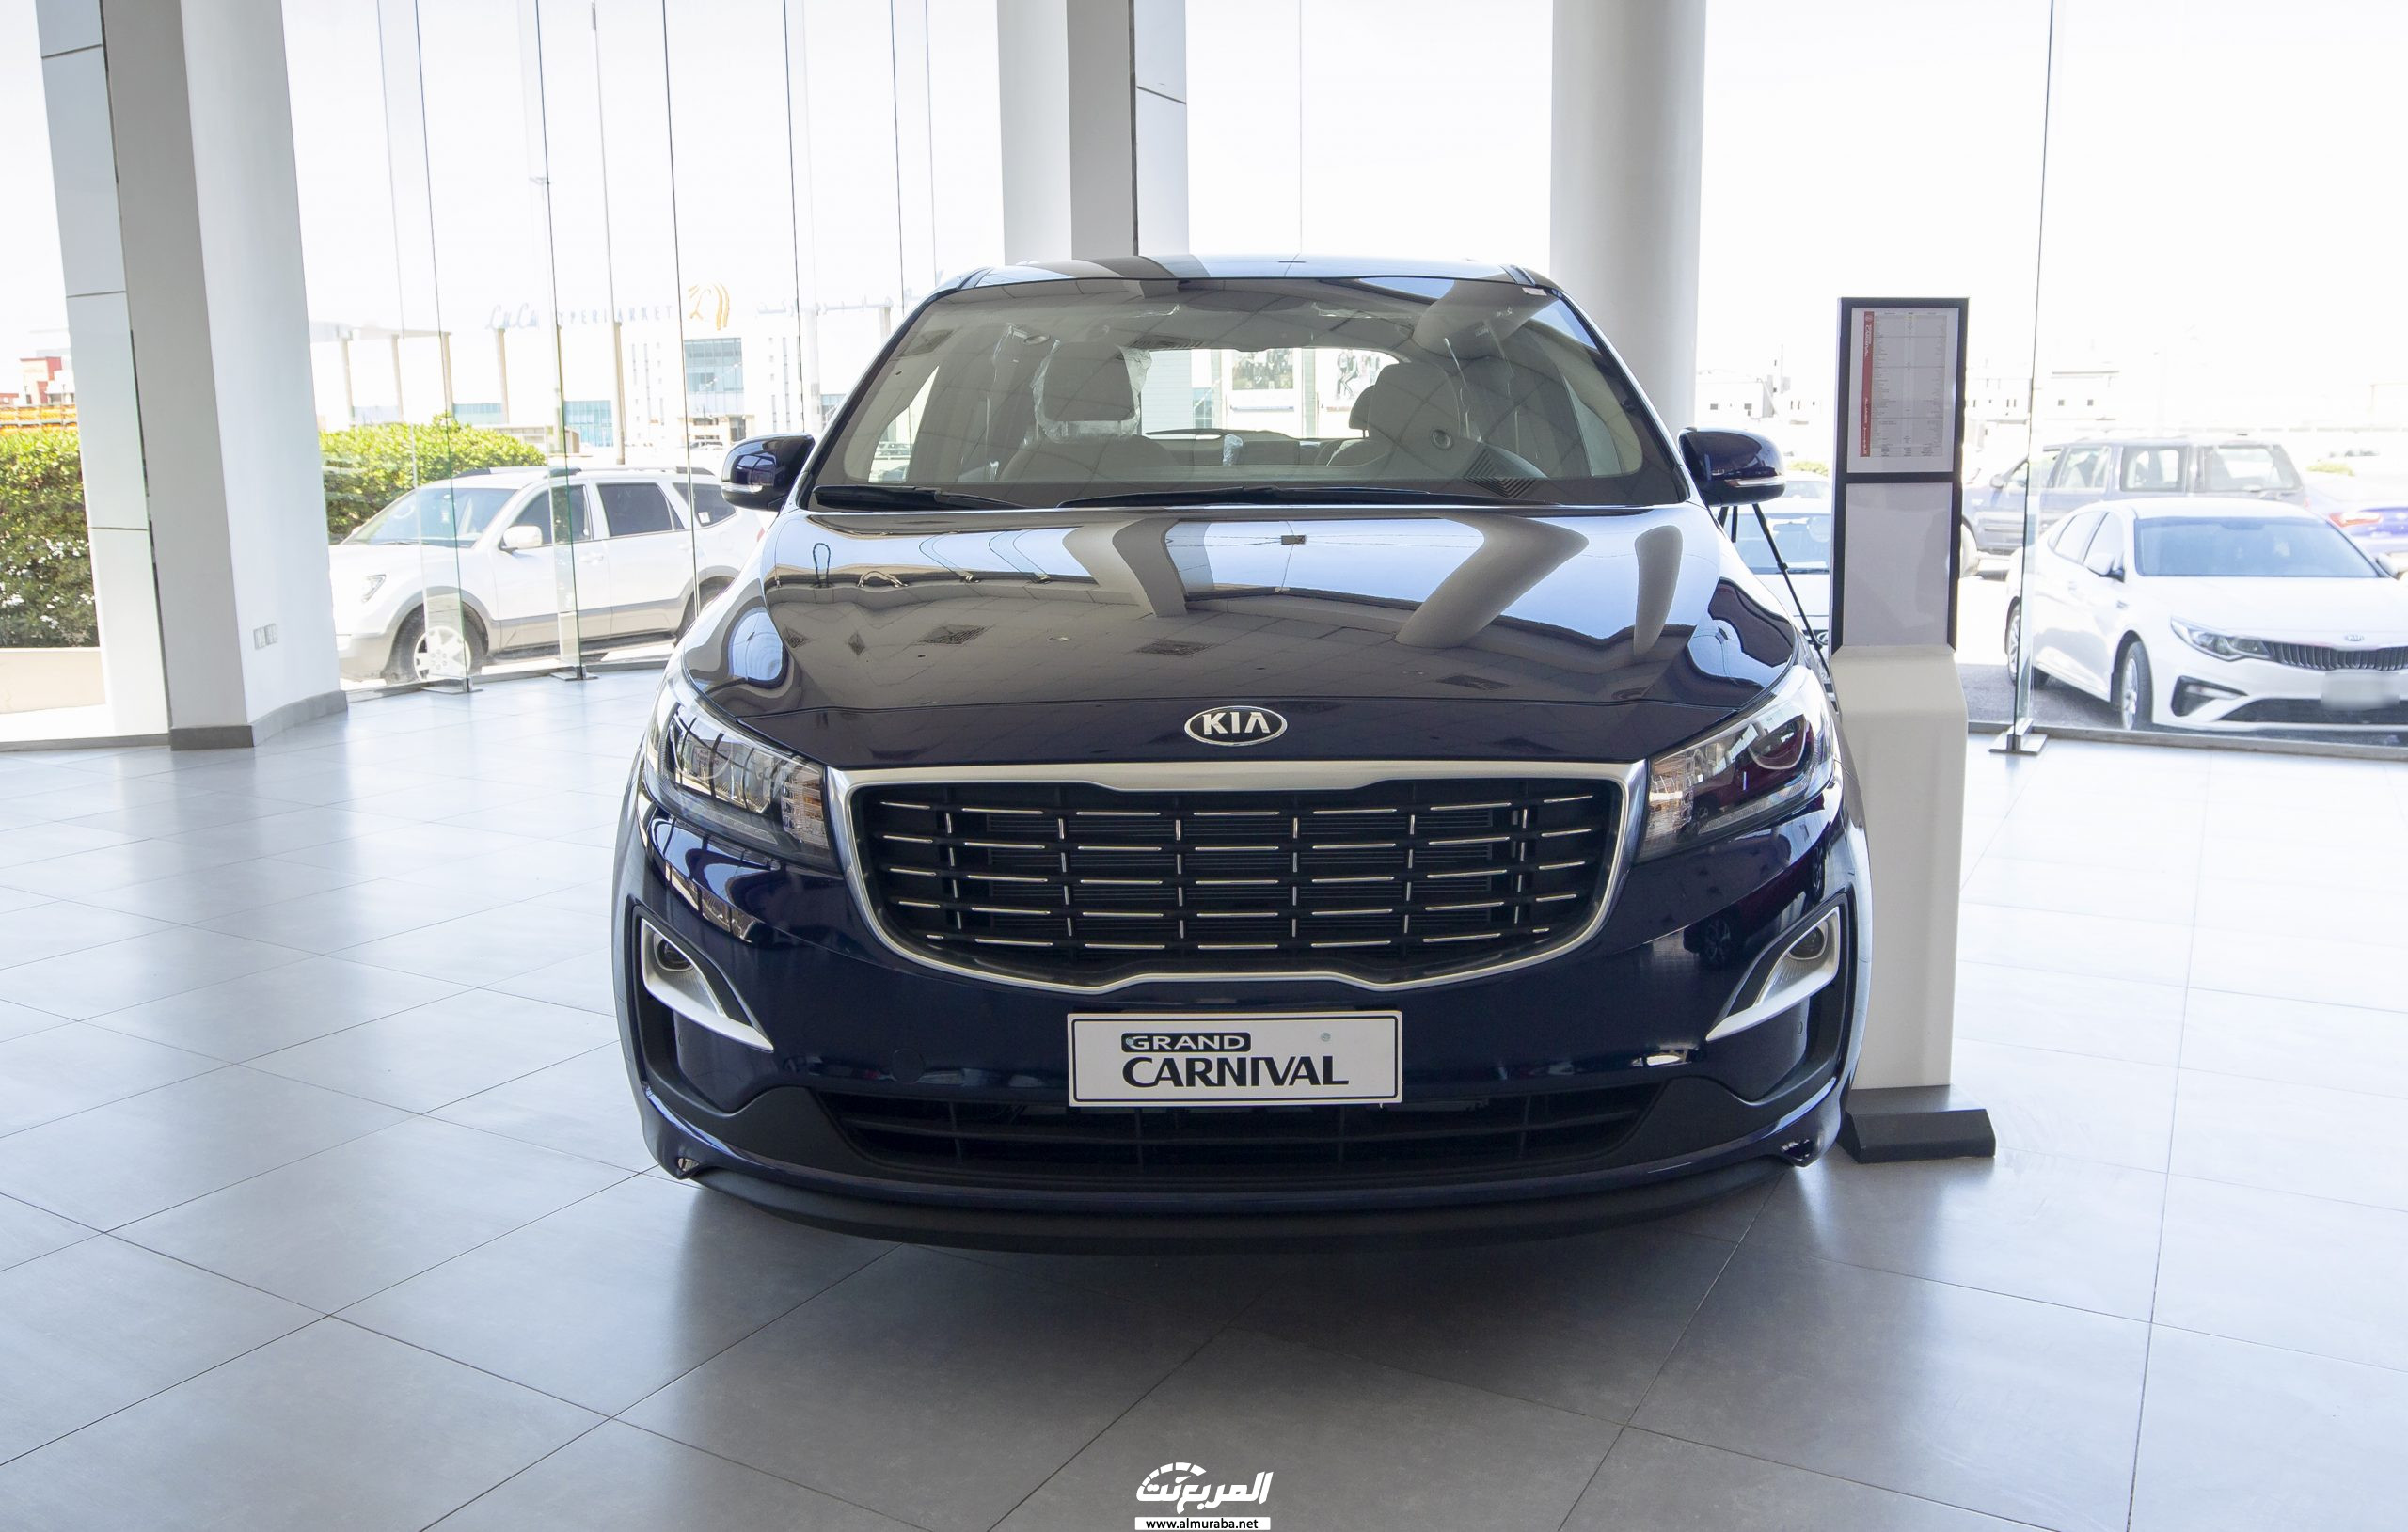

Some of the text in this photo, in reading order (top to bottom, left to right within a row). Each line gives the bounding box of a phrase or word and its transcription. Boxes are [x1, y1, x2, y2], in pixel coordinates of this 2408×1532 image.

[549, 305, 673, 326] YPERARKET
[1202, 711, 1271, 735] KIA
[1130, 1035, 1245, 1050] GRAND
[1122, 1055, 1350, 1088] CARNIVAL
